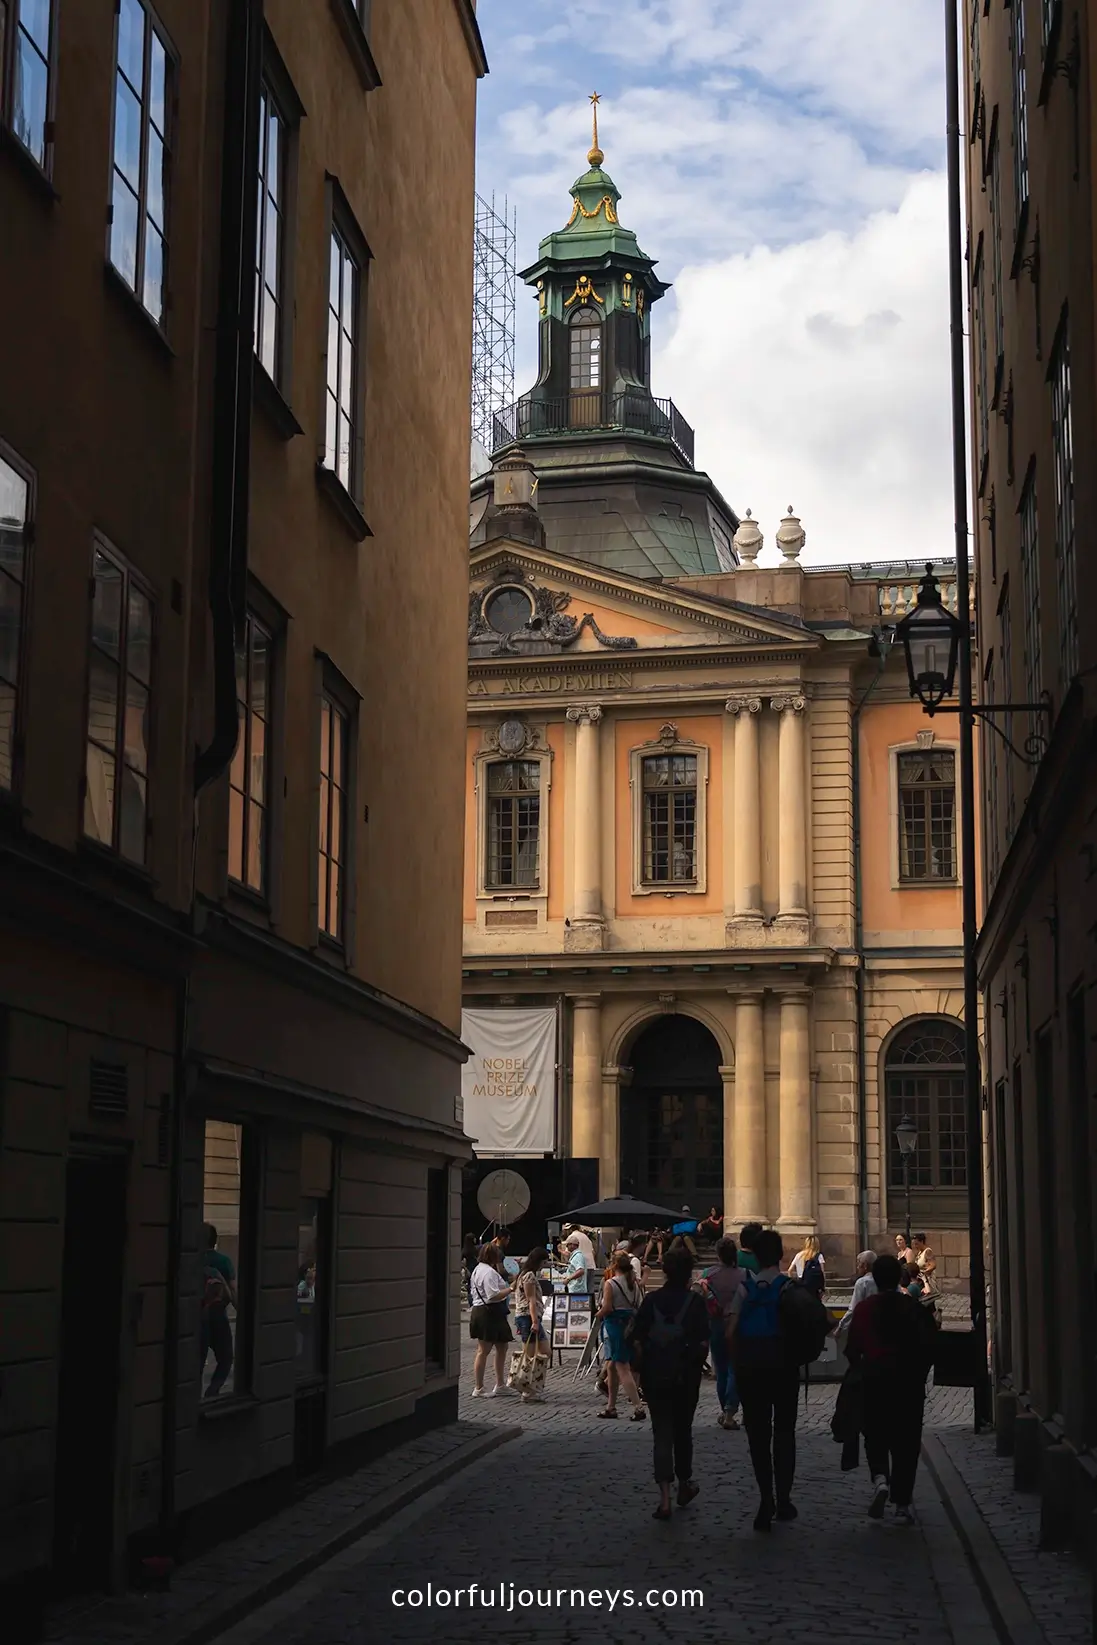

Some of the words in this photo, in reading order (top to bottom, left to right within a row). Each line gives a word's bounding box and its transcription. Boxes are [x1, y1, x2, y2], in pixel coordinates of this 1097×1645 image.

[502, 672, 633, 693] AKADEMIEN
[483, 1058, 529, 1070] NOBEL
[487, 1071, 525, 1084] PRIZE
[472, 1084, 538, 1097] MUSEUM
